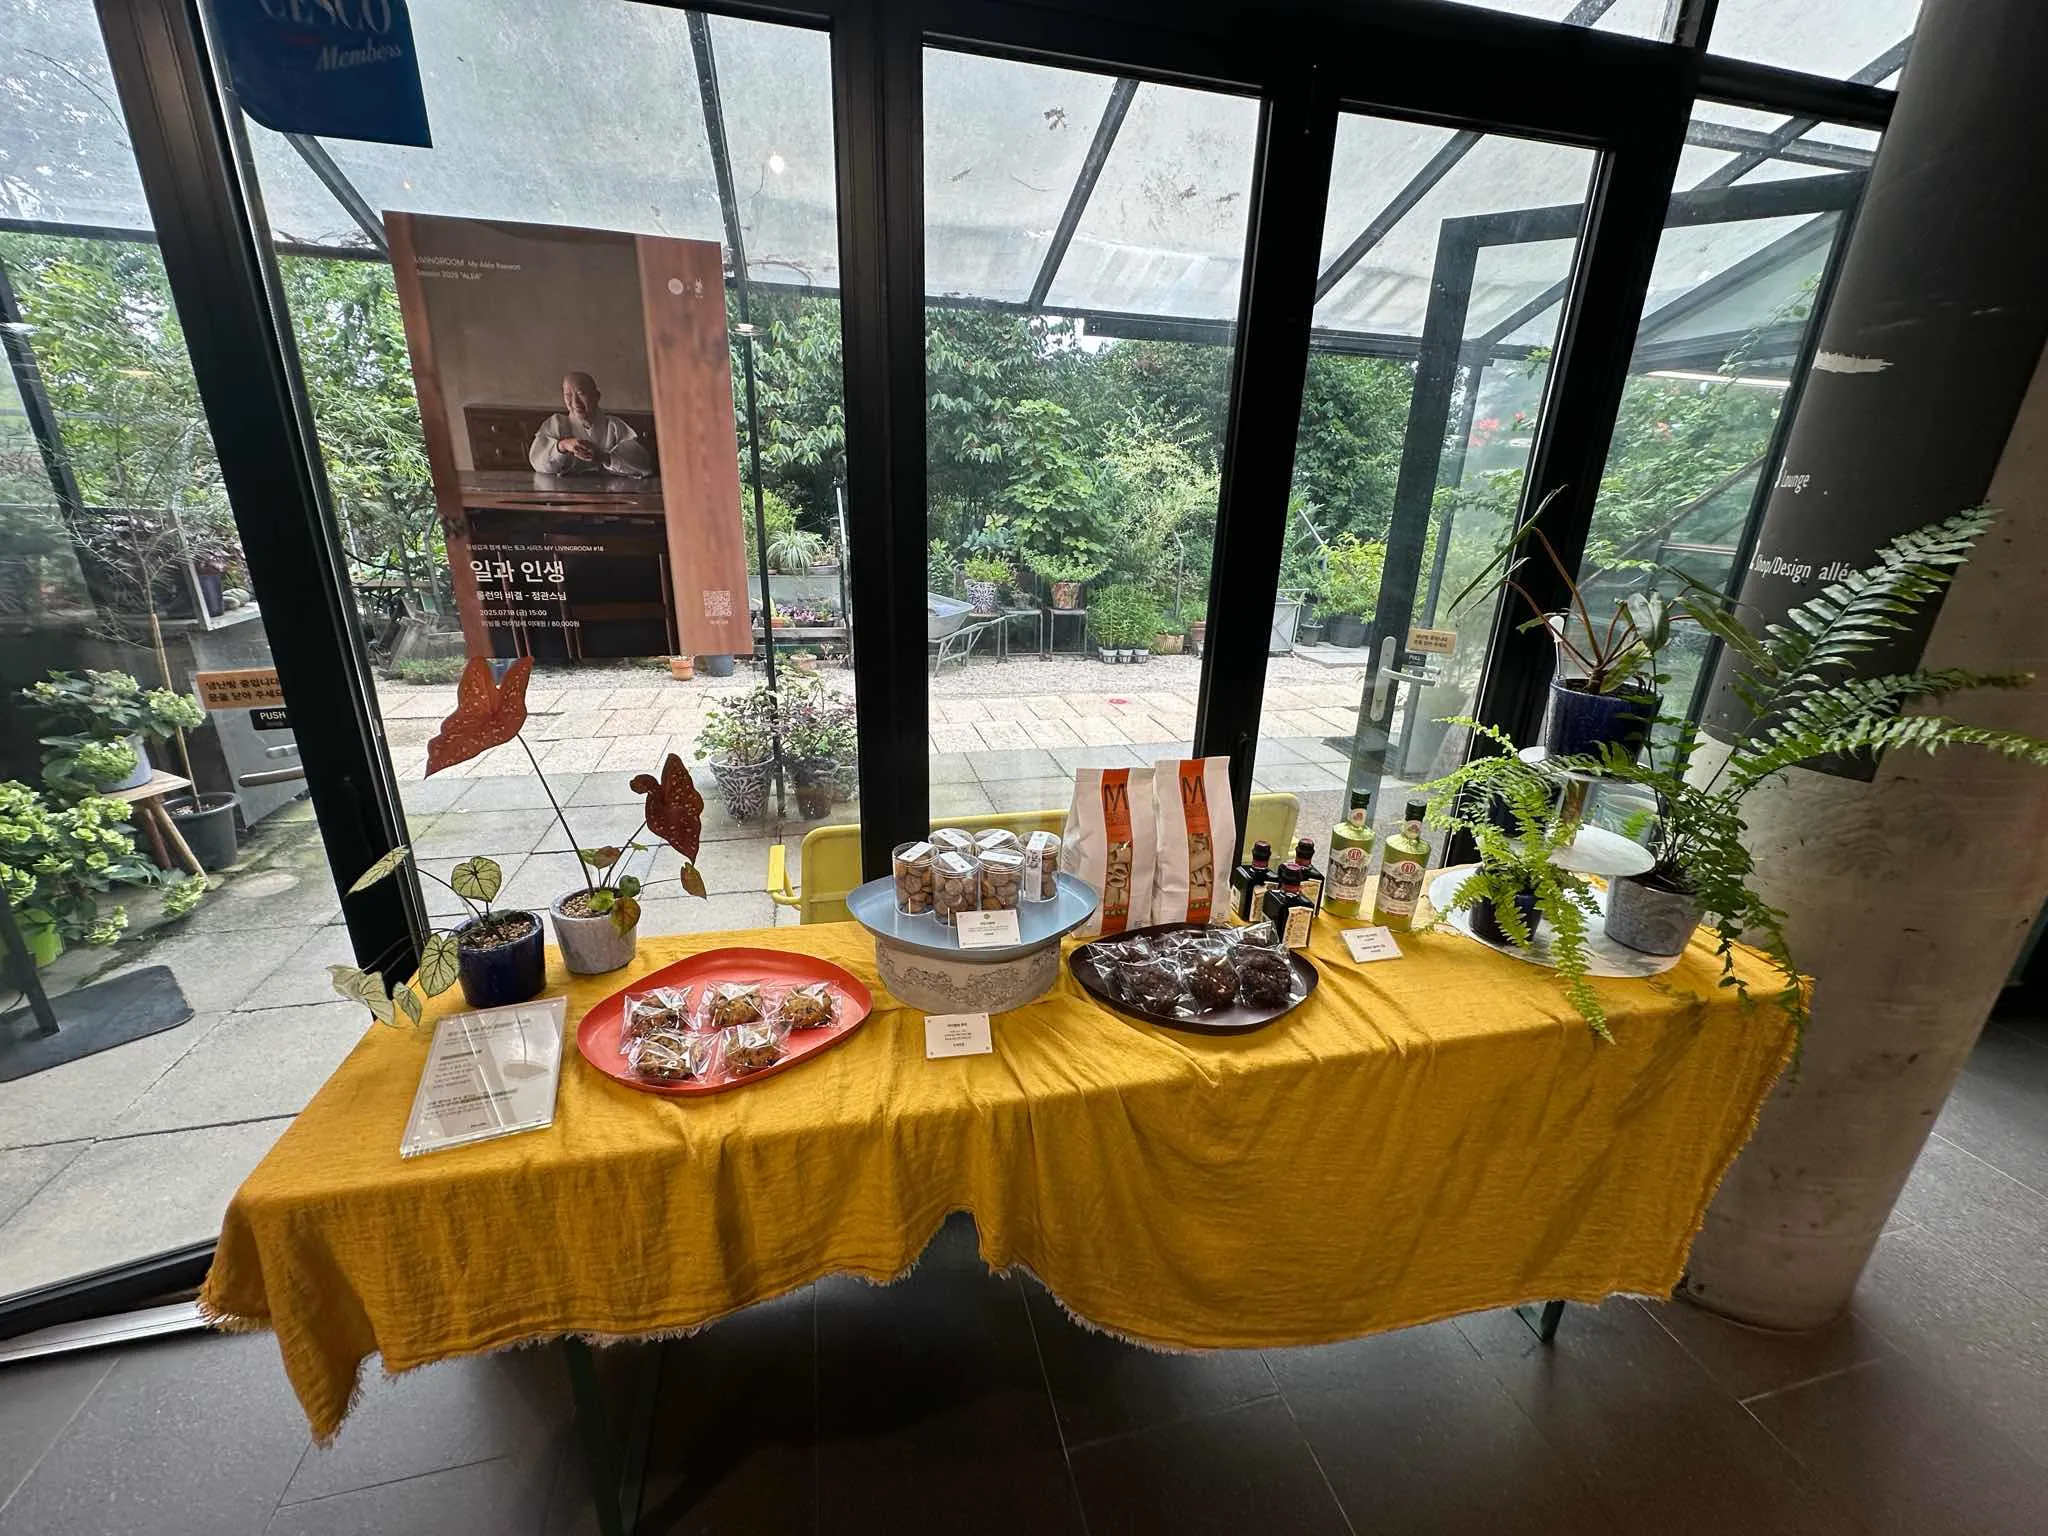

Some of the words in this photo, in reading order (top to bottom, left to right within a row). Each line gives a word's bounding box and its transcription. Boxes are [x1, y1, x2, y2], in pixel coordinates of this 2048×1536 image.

[314, 36, 402, 72] Members
[1781, 470, 1810, 493] Lounge
[469, 559, 515, 583] 일과
[520, 560, 566, 583] 인생
[531, 591, 567, 601] 정관스님
[240, 678, 279, 688] 중입니다
[260, 711, 287, 720] PUSH
[1103, 784, 1129, 812] M
[1182, 776, 1206, 804] M
